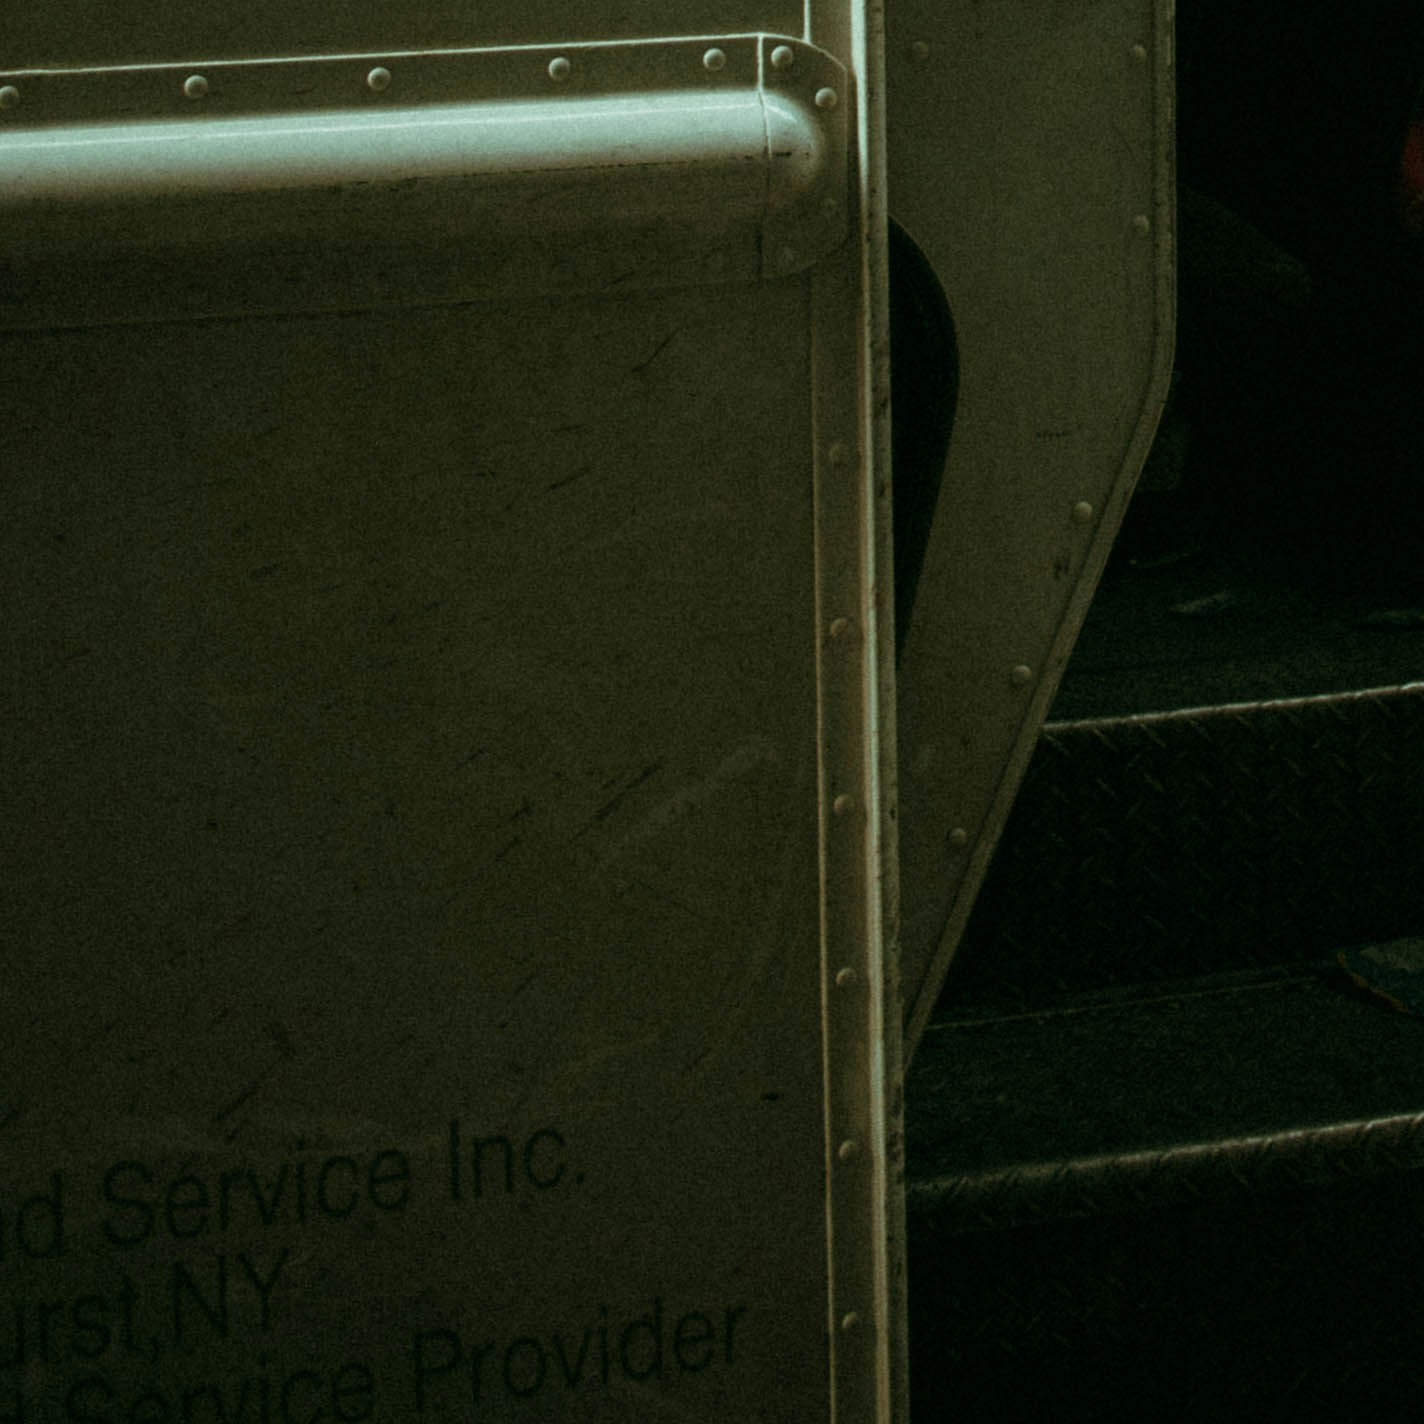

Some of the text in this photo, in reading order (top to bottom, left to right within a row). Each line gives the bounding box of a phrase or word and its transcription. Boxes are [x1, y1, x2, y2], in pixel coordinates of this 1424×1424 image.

[0, 1119, 585, 1258] d Service Inc.
[413, 1295, 748, 1412] Provider
